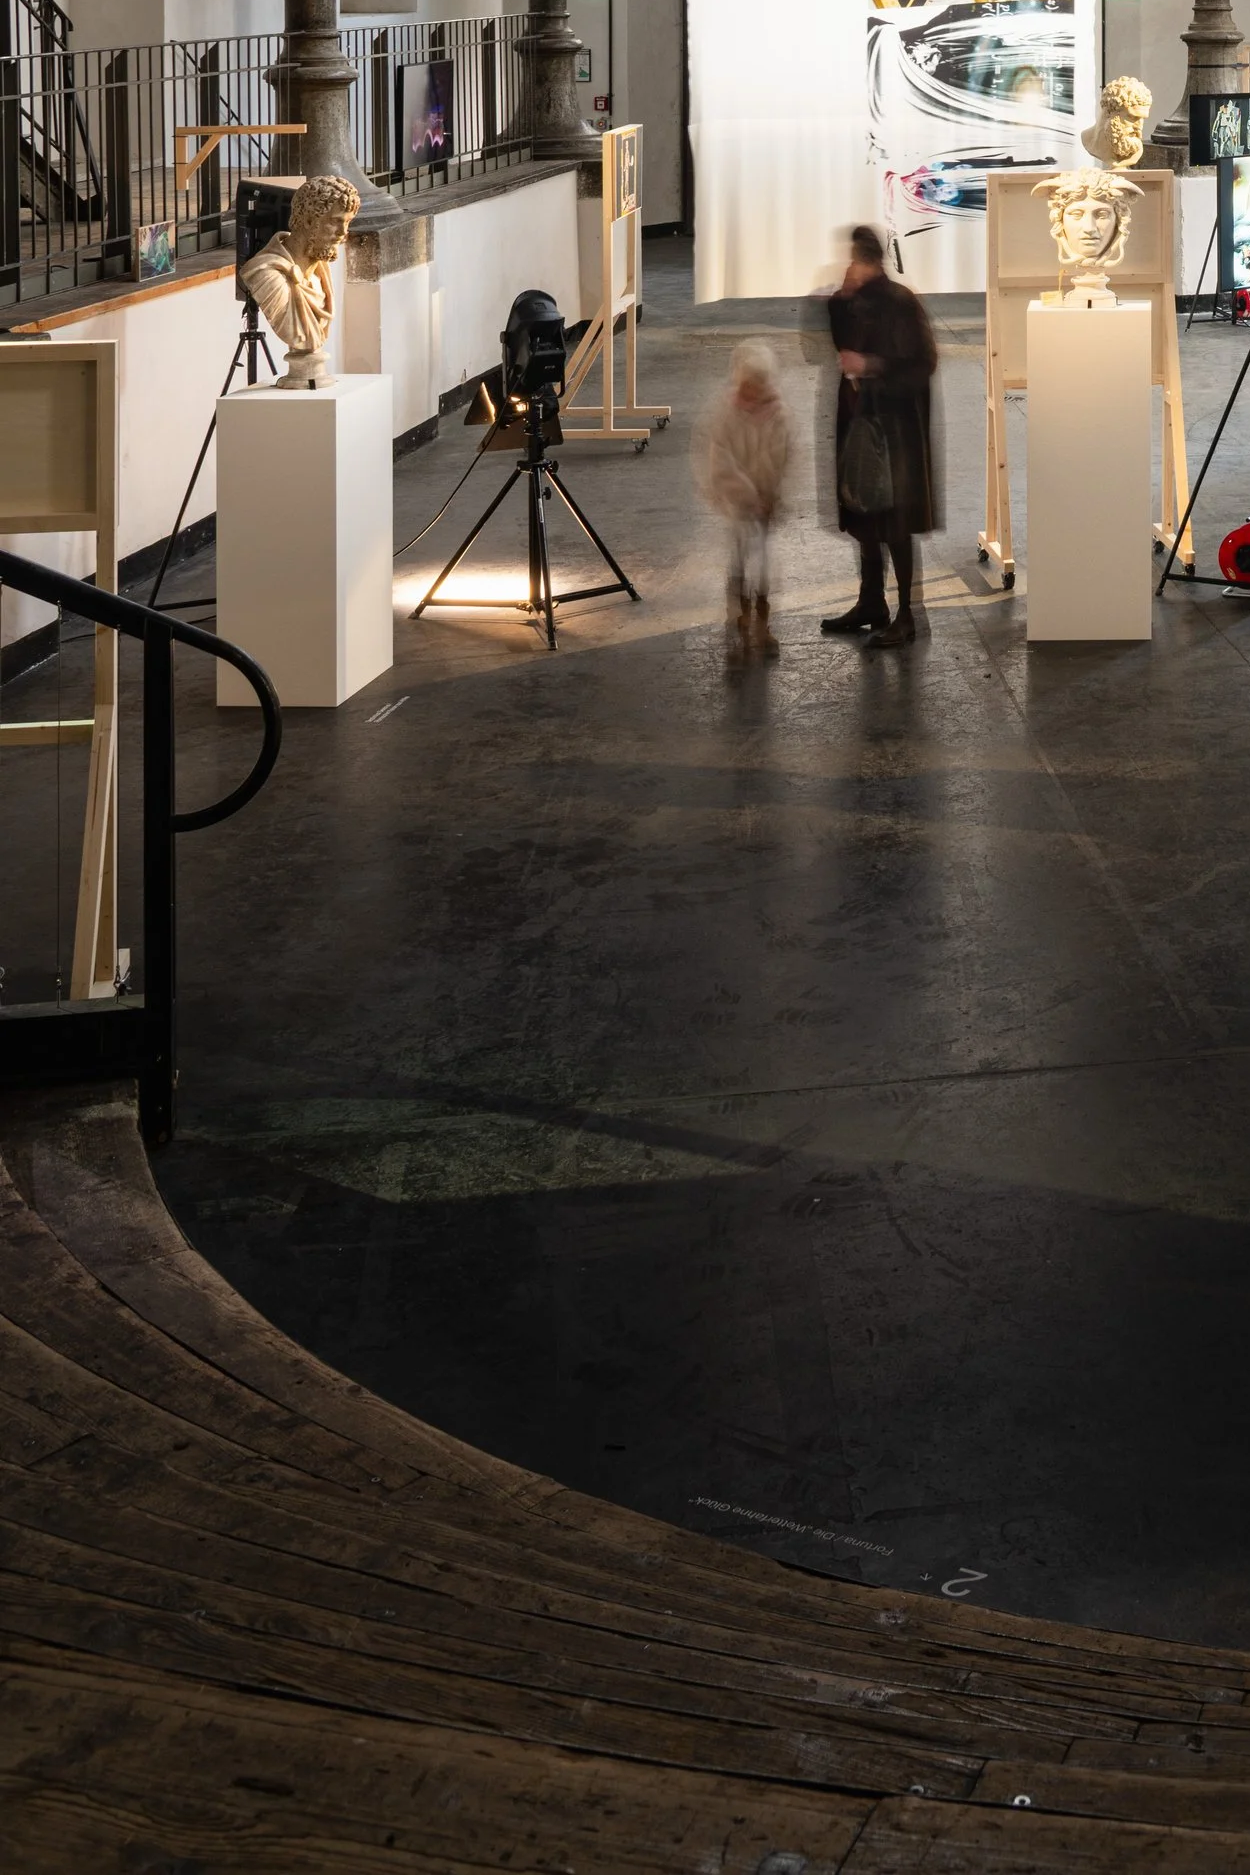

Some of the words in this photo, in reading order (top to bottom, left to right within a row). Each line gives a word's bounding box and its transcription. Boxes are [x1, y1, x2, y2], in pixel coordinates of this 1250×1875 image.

[813, 1528, 836, 1541] Die
[844, 1534, 894, 1557] Fortuna
[940, 1567, 989, 1598] 2
